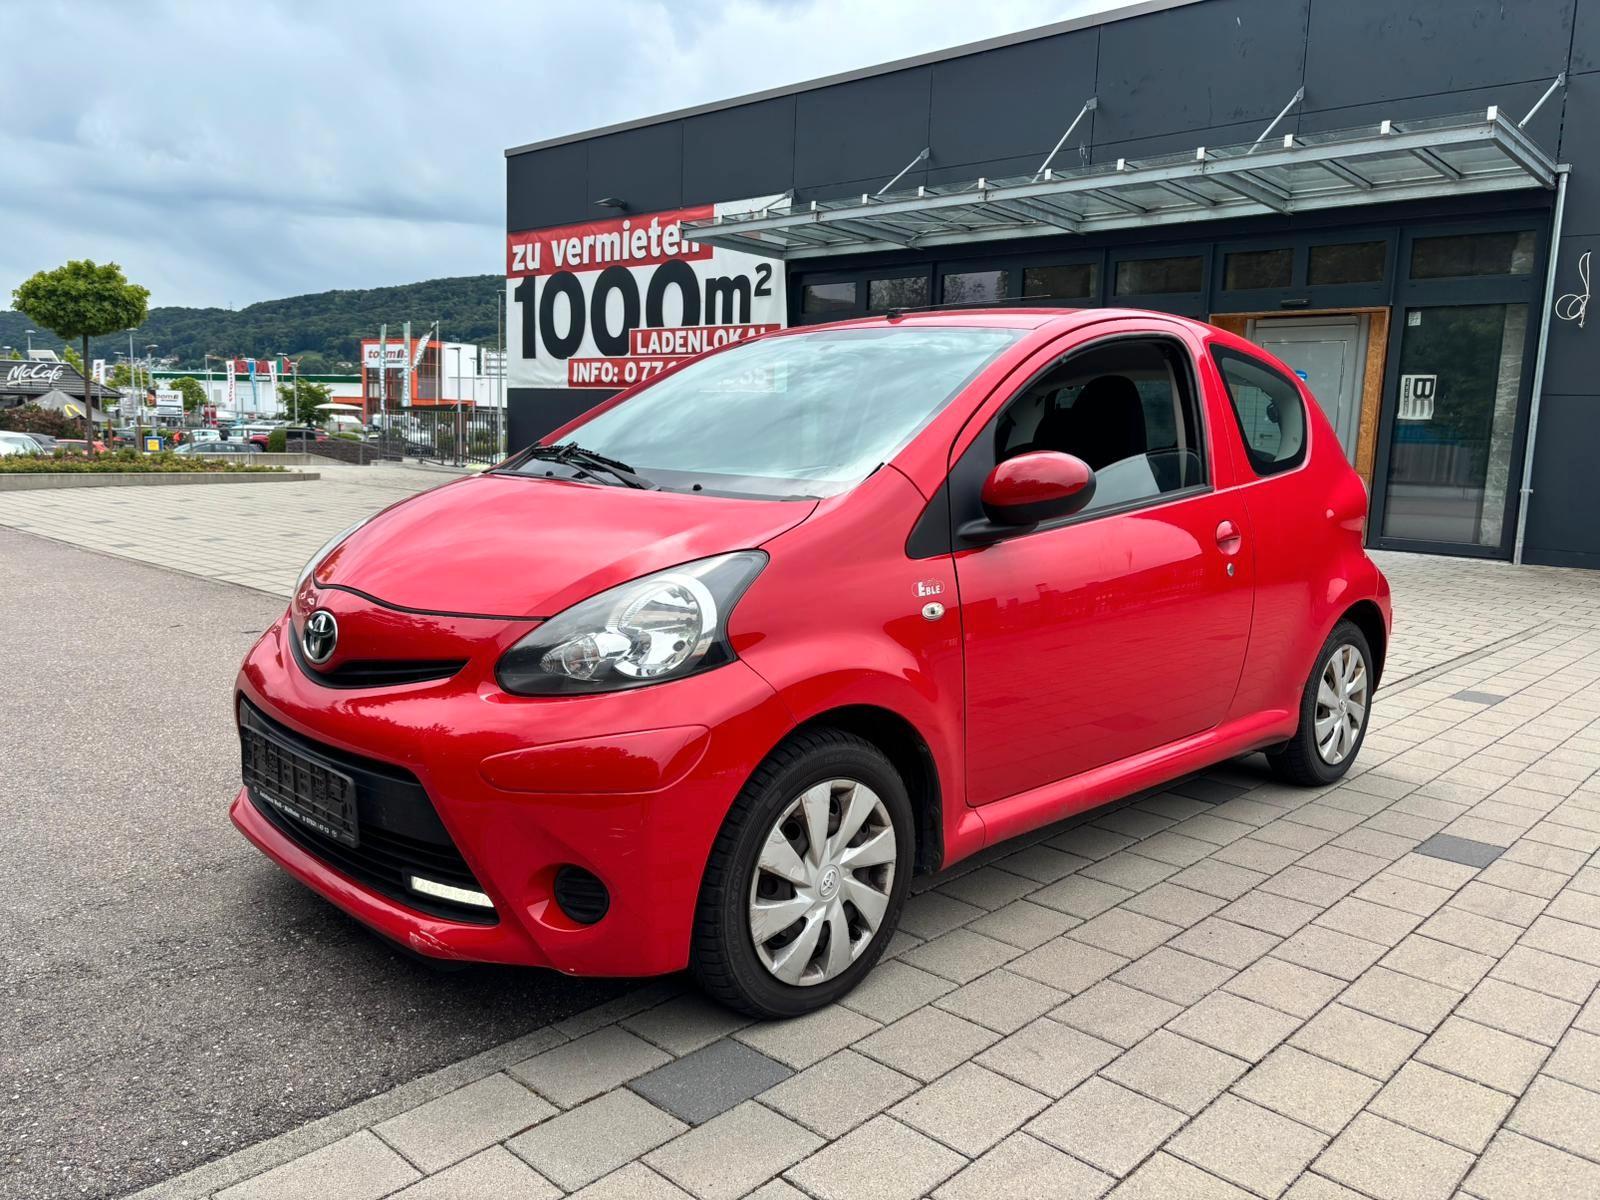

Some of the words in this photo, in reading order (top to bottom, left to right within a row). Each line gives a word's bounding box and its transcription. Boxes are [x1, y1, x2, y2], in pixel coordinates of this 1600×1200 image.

[512, 242, 541, 271] zu
[637, 327, 766, 354] LADENLOK
[368, 350, 396, 358] tom
[573, 361, 619, 383] INFO:
